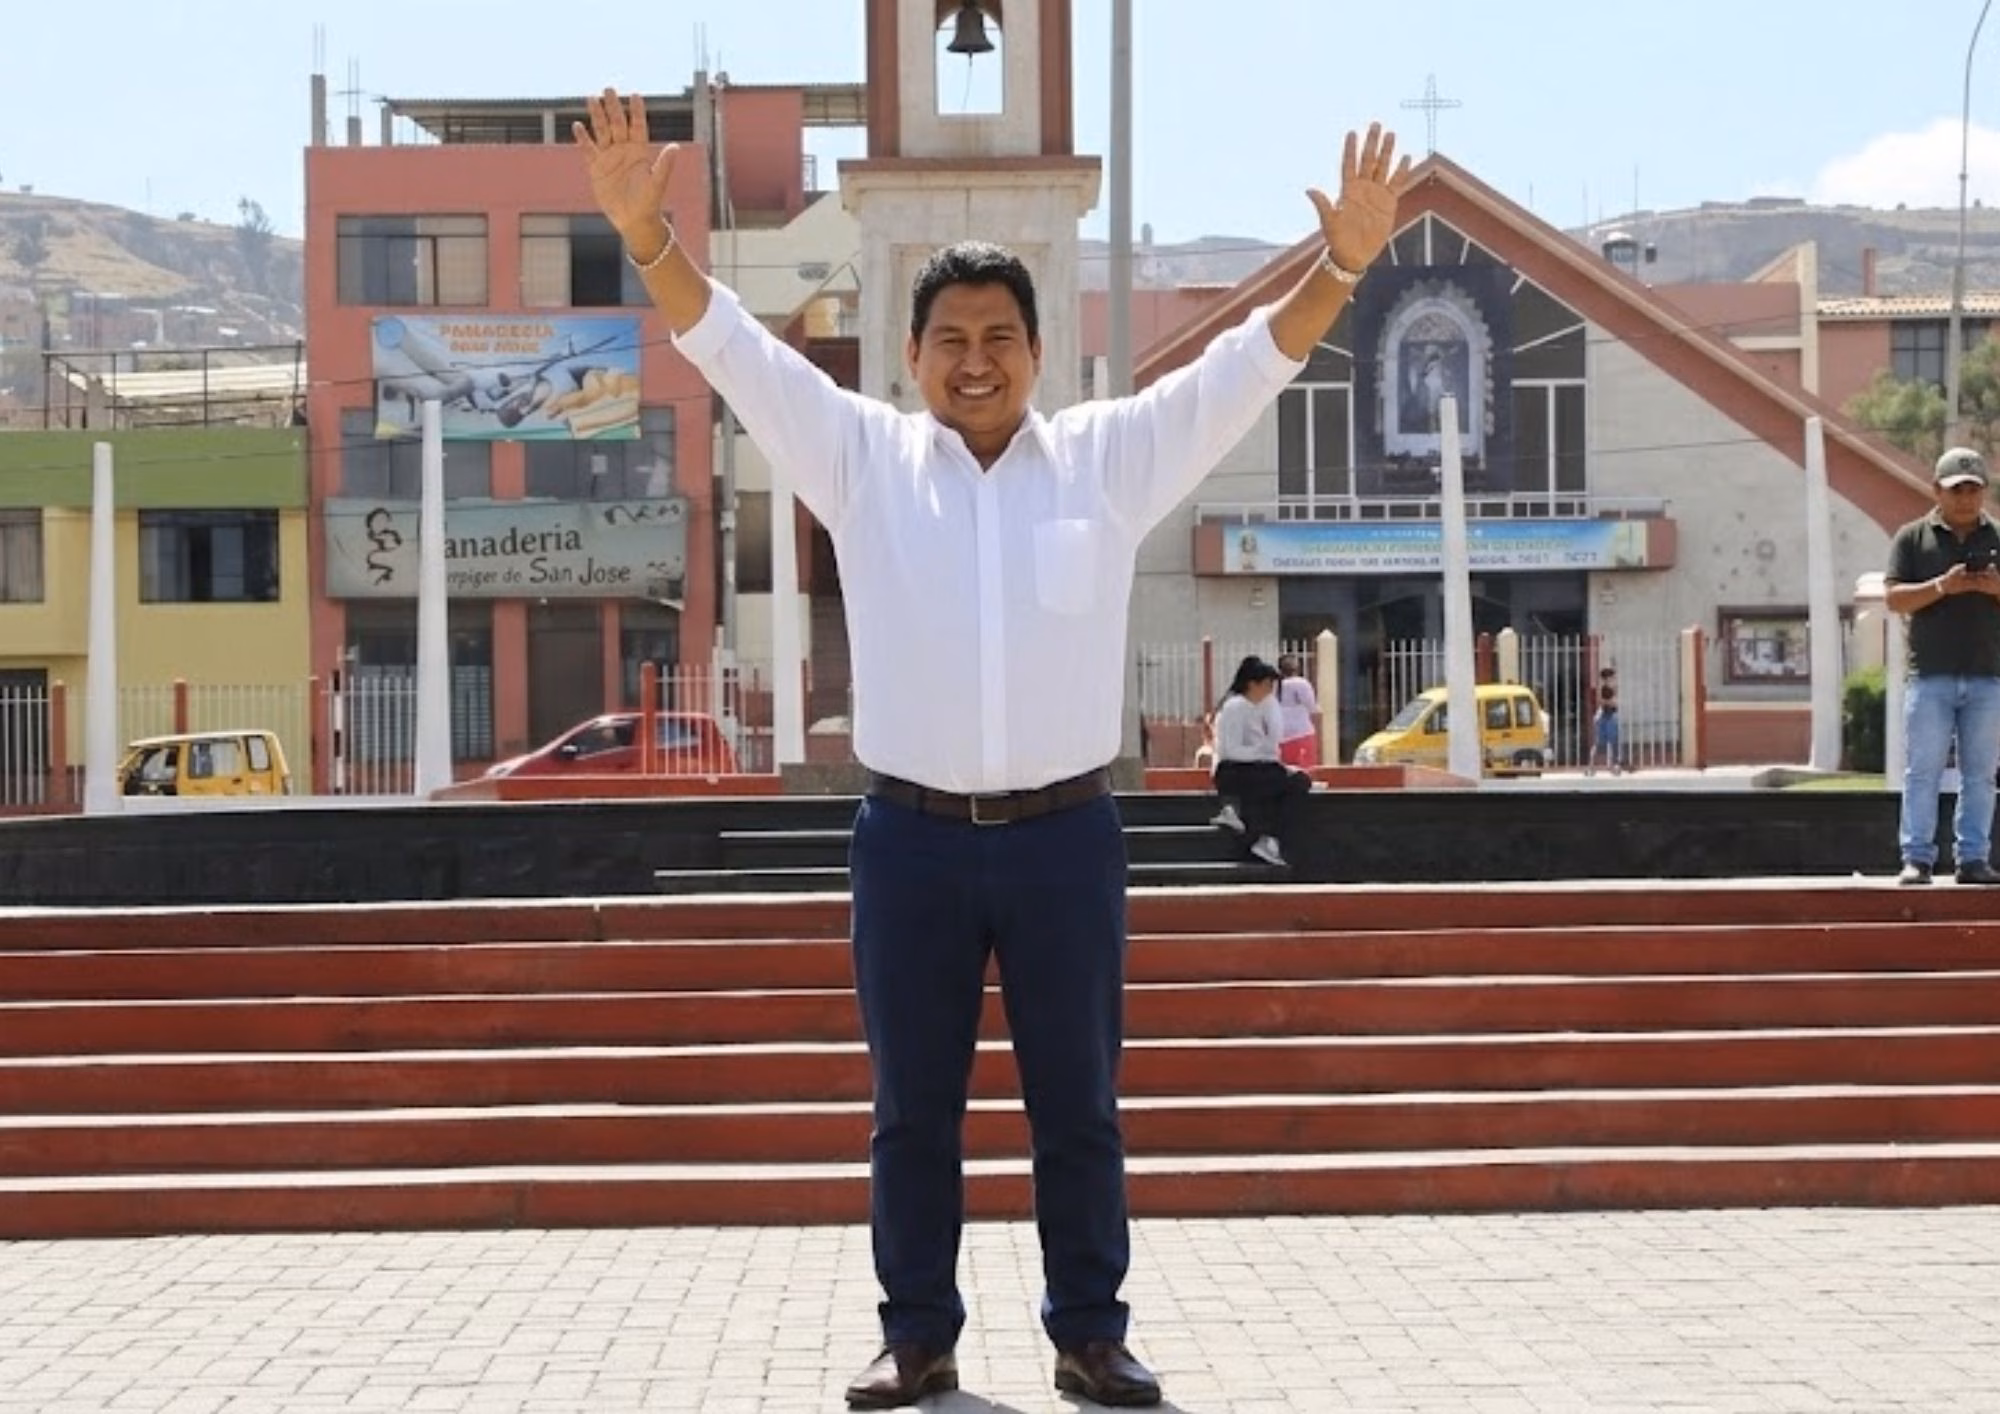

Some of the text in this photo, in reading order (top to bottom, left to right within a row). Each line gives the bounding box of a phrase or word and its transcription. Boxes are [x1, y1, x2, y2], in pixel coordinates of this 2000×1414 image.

[417, 515, 582, 559] anaderia
[529, 556, 573, 584] San
[577, 556, 631, 586] Jose
